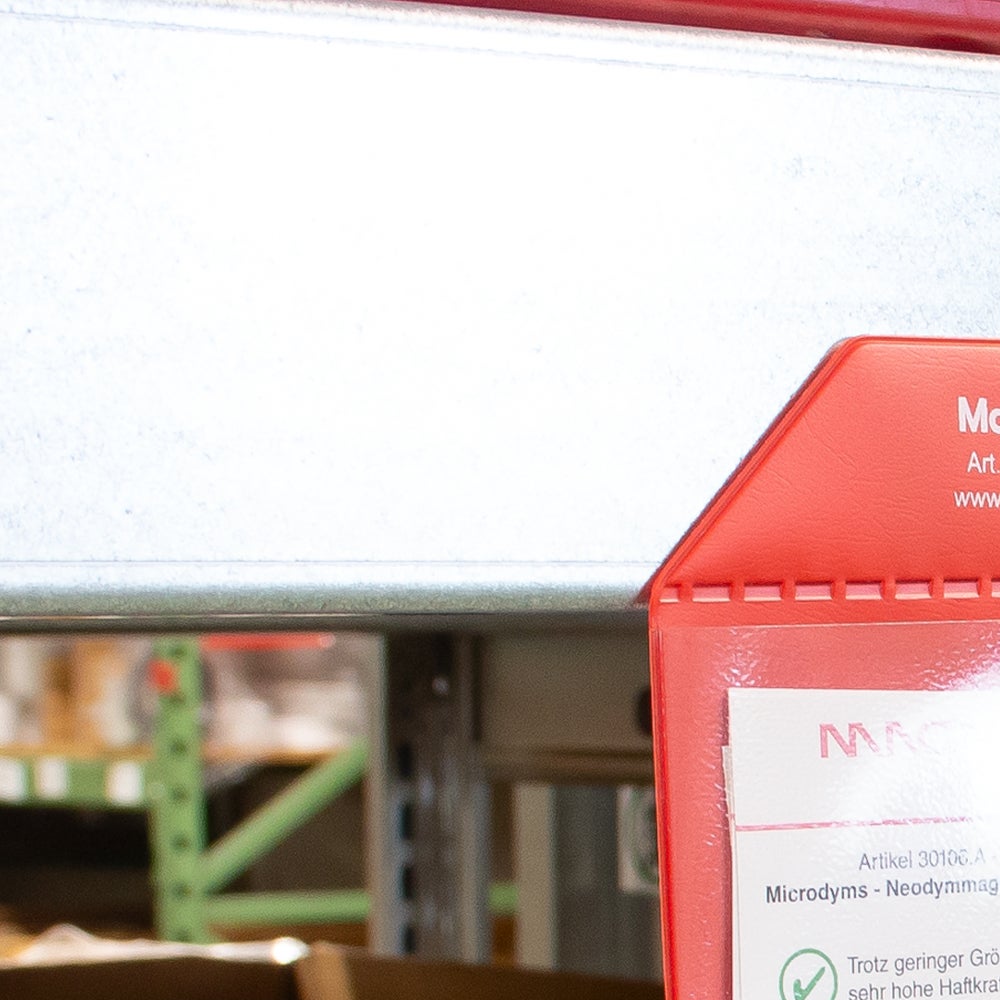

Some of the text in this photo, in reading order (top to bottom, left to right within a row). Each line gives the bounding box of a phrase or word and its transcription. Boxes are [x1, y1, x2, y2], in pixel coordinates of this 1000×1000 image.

[858, 851, 914, 871] Artikel
[765, 882, 869, 905] Microdyms
[847, 956, 889, 976] Trotz
[893, 951, 965, 977] geringer
[891, 981, 934, 1000] hohe
